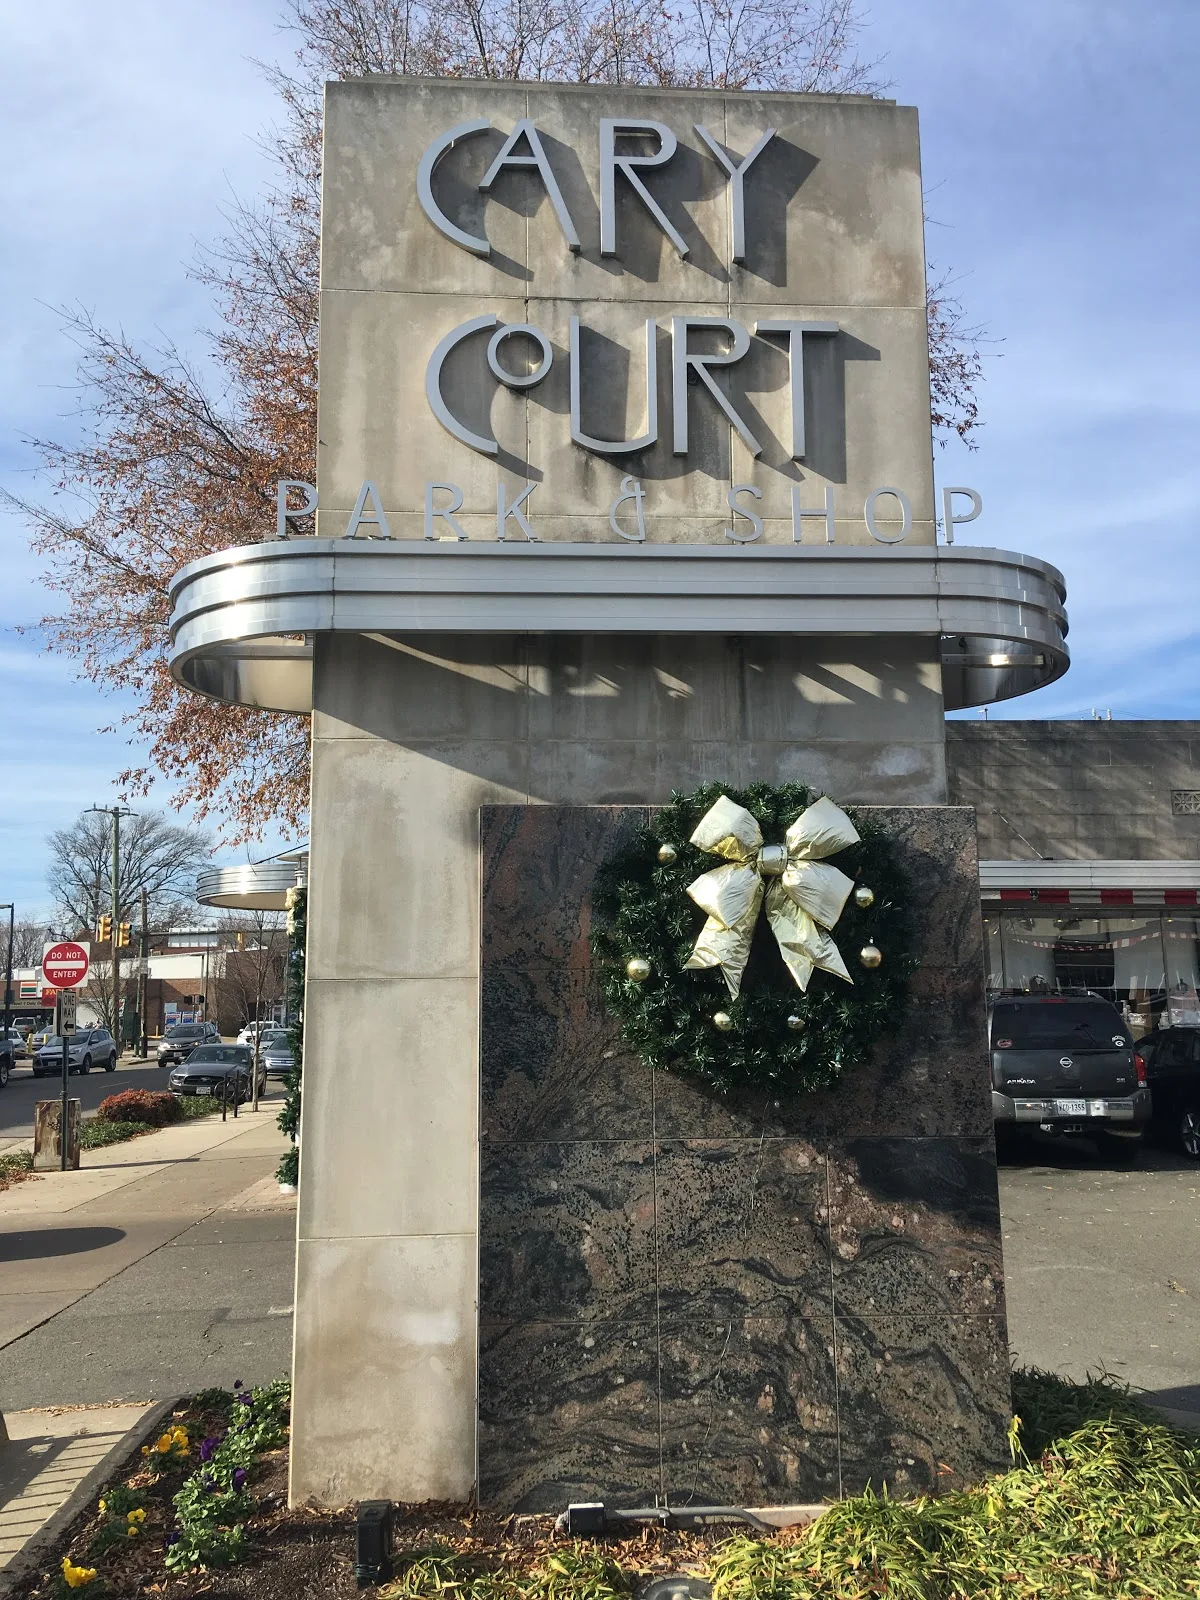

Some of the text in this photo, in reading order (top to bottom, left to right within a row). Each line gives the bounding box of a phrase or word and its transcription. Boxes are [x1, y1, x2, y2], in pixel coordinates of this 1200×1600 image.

[416, 117, 779, 264] CARY
[426, 313, 840, 461] COURT
[276, 475, 984, 546] PARK & SHOP
[63, 994, 75, 1006] ONE
[63, 1008, 75, 1018] WAY
